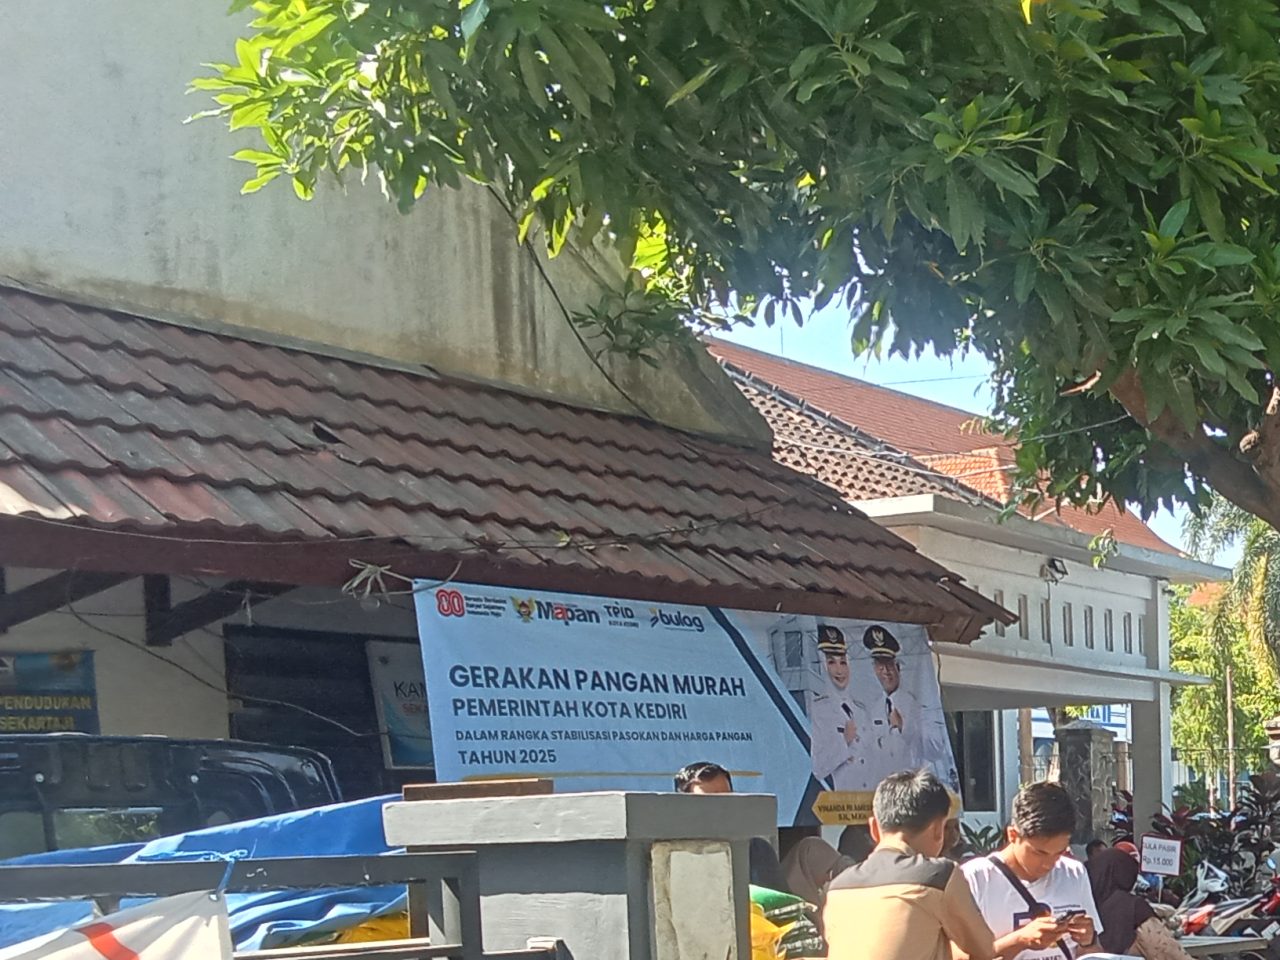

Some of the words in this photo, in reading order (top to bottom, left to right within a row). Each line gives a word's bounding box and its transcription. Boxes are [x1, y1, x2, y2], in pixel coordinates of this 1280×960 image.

[436, 589, 465, 617] 80
[536, 600, 600, 626] Mapan
[449, 664, 571, 690] GERAKAN
[574, 669, 669, 694] PANGAN
[672, 674, 746, 697] MURAH
[452, 698, 580, 718] PEMERINTAH
[582, 700, 632, 719] KOTA
[634, 702, 688, 720] KEDIRI
[455, 730, 499, 741] DALAM
[500, 730, 549, 741] RANGKA
[551, 730, 612, 741] STABILISASI
[612, 731, 660, 742] PASOKAN
[661, 732, 683, 742] DAN
[683, 732, 717, 742] HARGA
[716, 731, 753, 742] PANGAN
[458, 750, 517, 765] TAHUN
[519, 748, 557, 764] 2025
